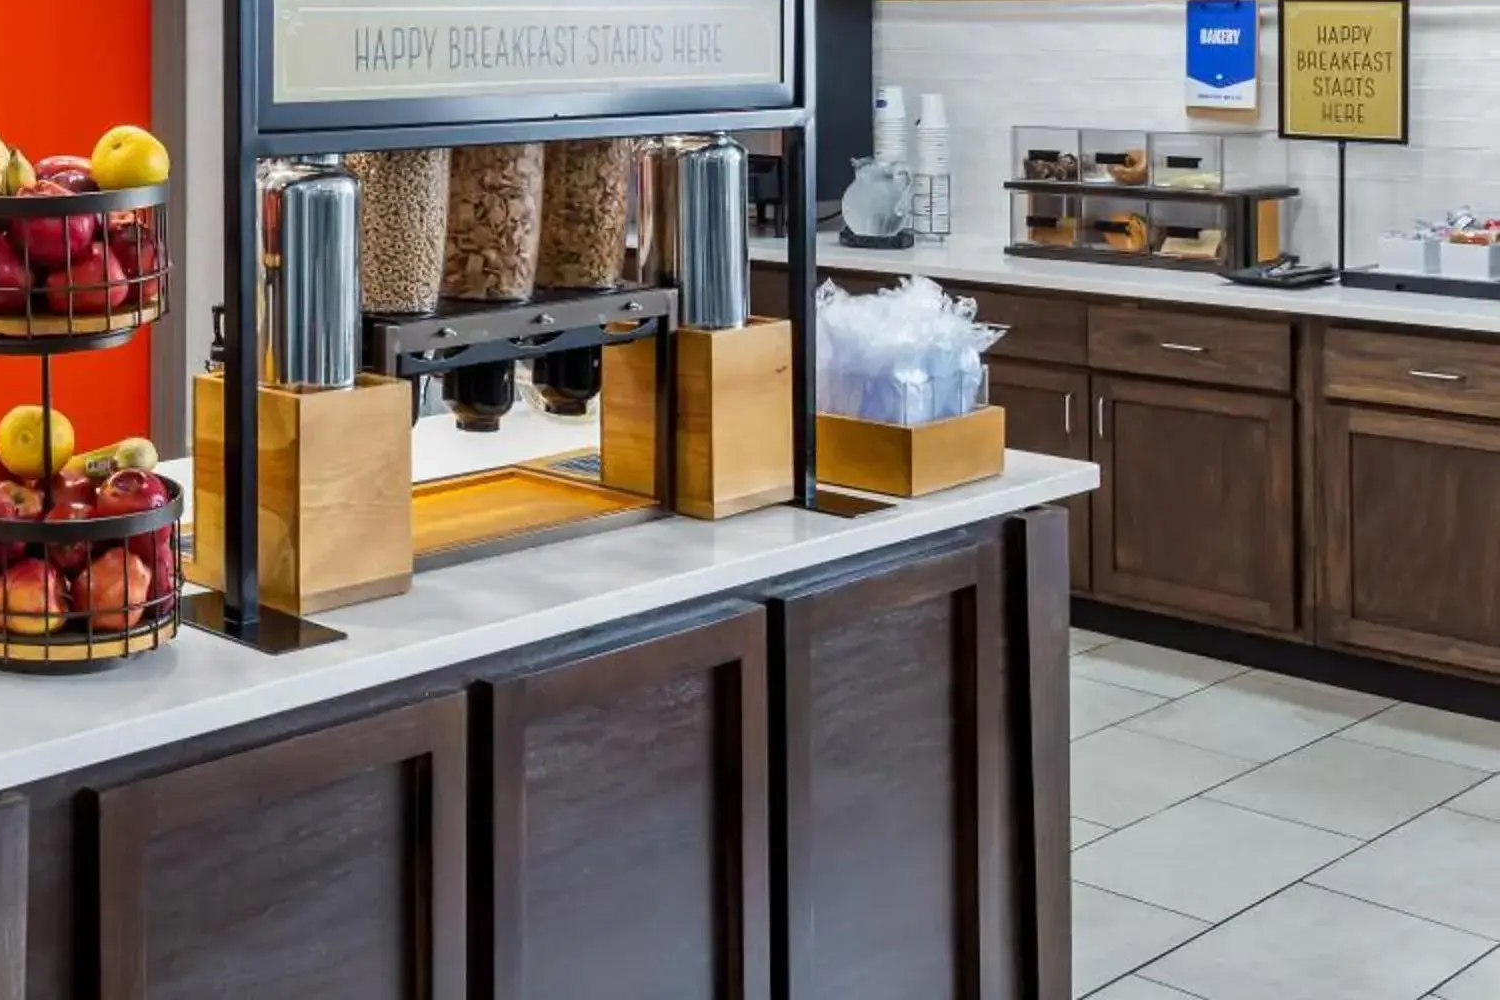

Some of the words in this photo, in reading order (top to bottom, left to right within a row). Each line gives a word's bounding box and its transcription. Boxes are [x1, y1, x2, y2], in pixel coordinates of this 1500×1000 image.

[1200, 28, 1242, 46] BAKERY
[1316, 25, 1374, 45] HAPPY
[354, 26, 438, 73] HAPPY
[448, 24, 578, 70] BREAKFAST
[586, 24, 665, 66] STARTS
[672, 23, 725, 65] HERE
[1297, 51, 1394, 73] BREAKFAST
[1312, 77, 1376, 99] STARTS
[1321, 103, 1366, 125] HERE
